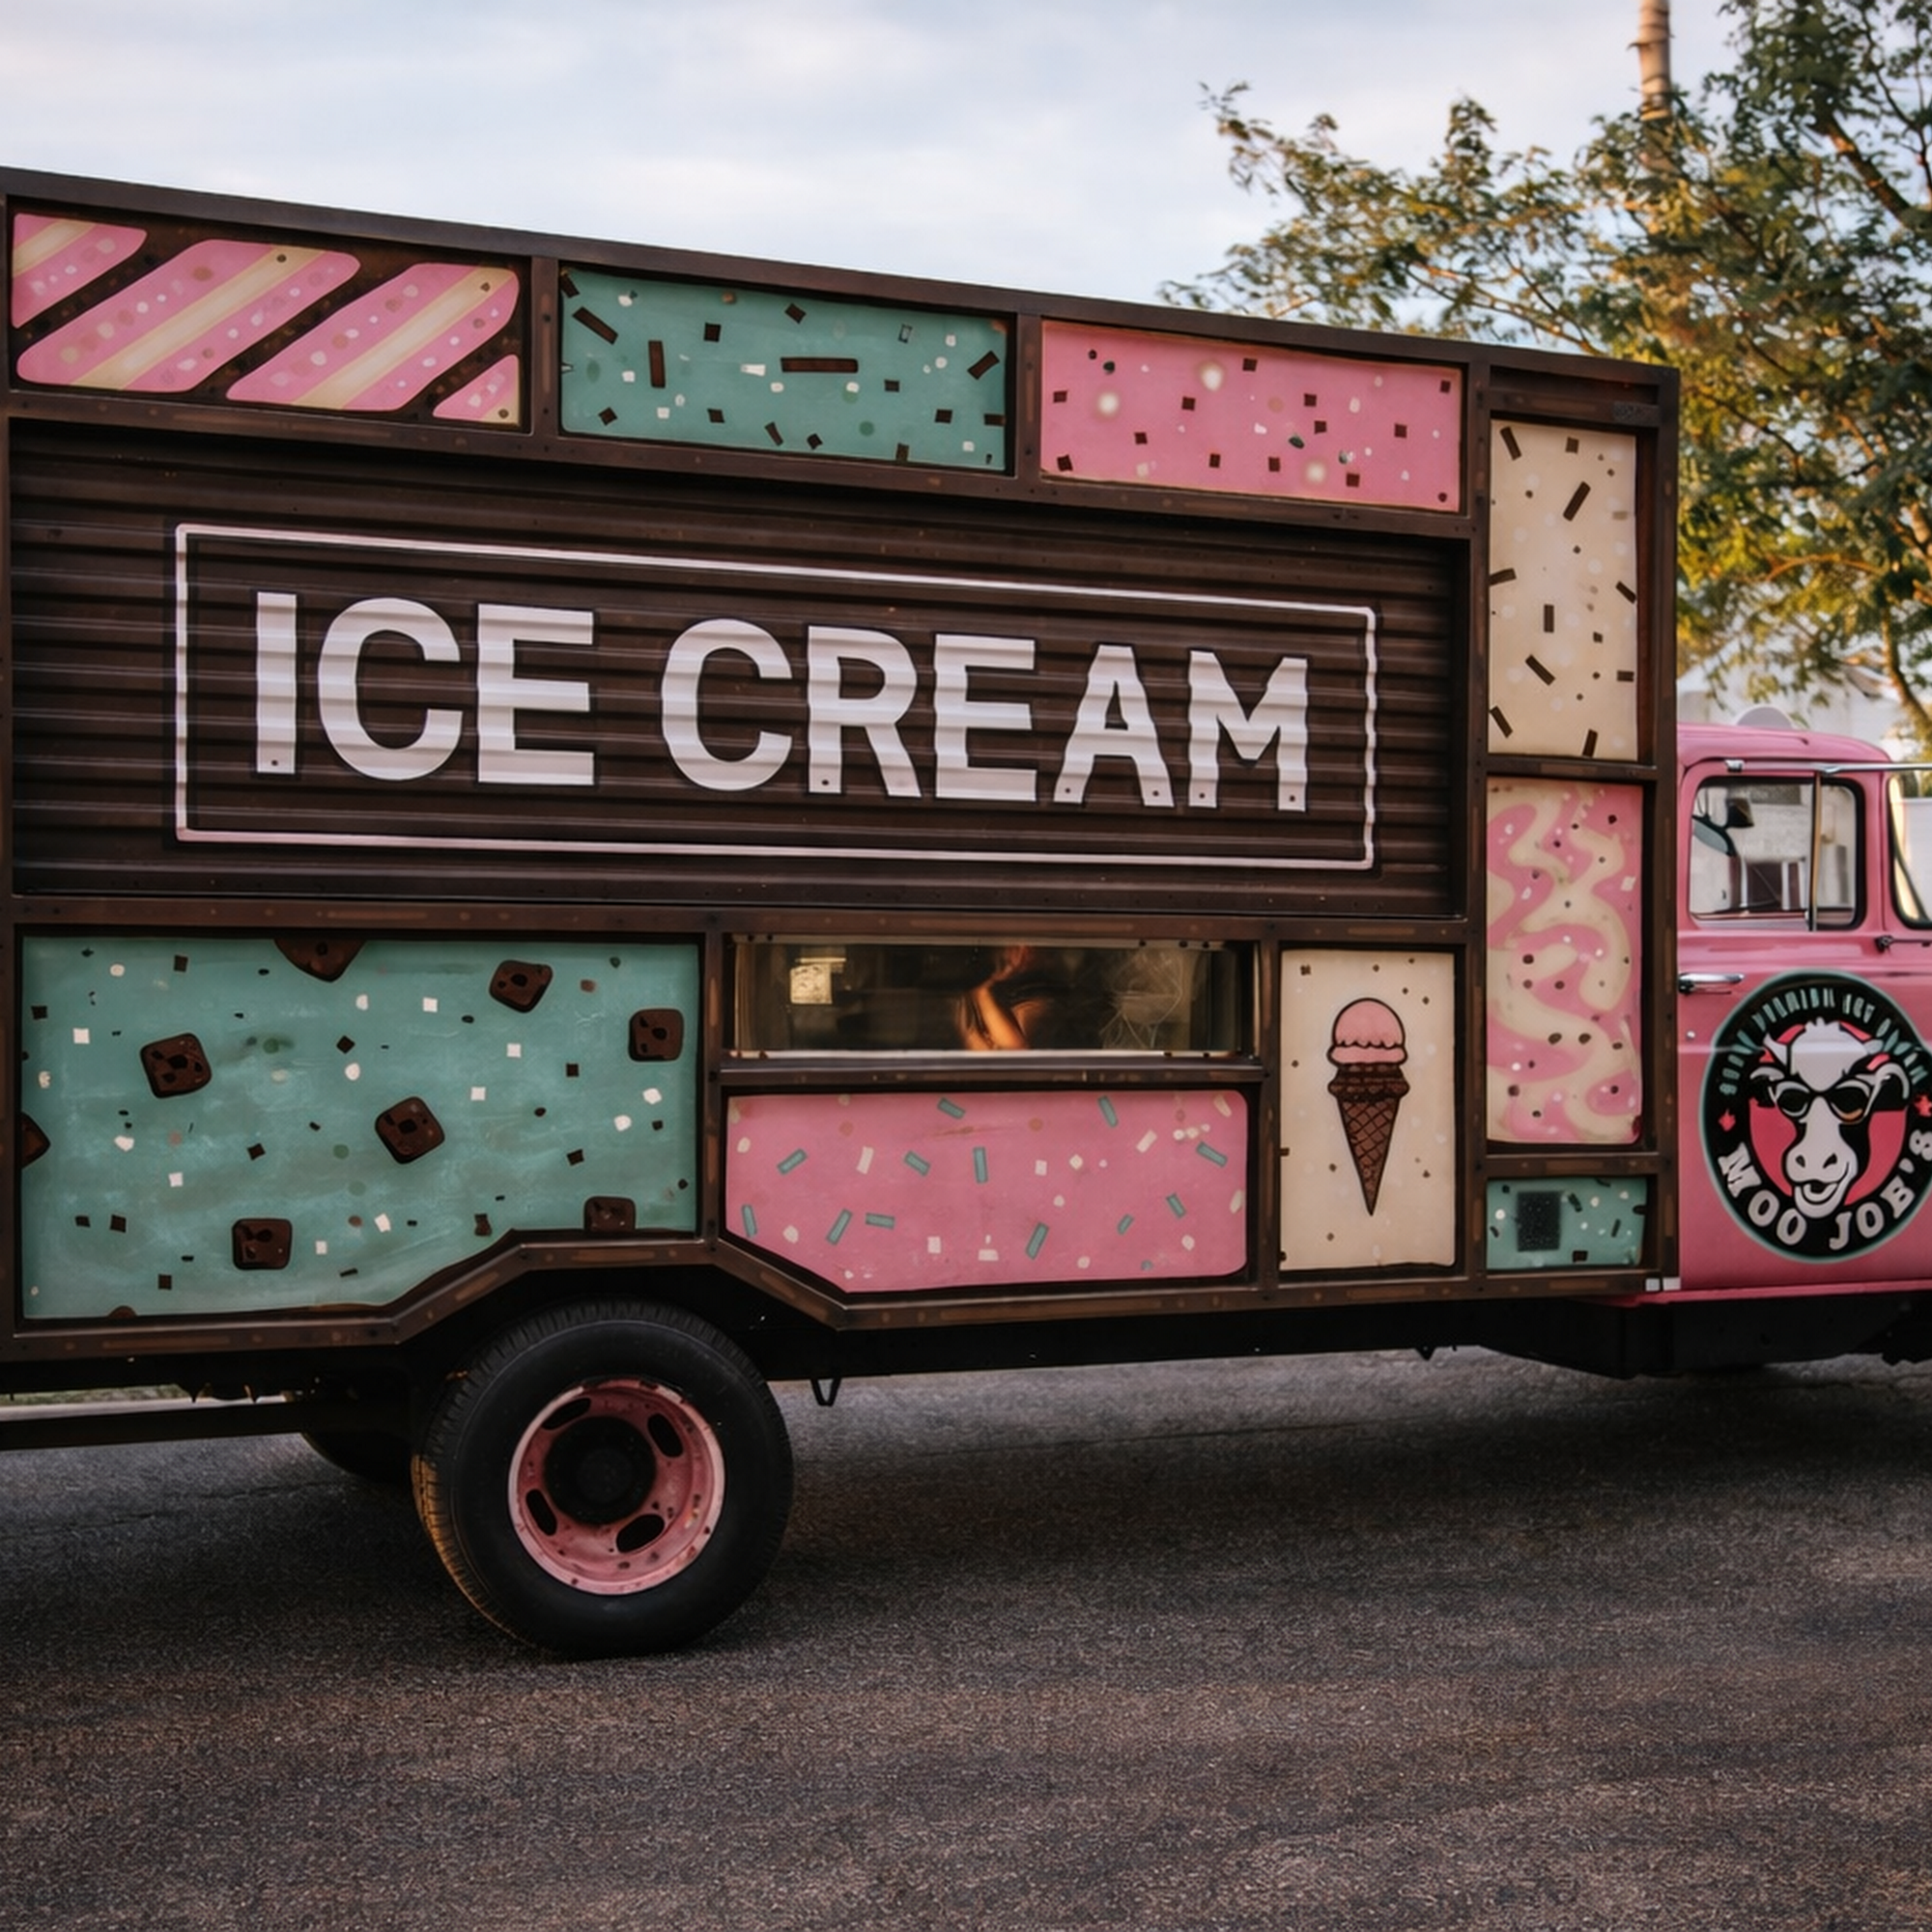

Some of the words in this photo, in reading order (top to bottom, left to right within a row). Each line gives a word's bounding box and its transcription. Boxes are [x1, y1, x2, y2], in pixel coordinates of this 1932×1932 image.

[257, 591, 594, 785] ICE
[661, 618, 1308, 812] CREAM
[1718, 1142, 1806, 1246] MOO
[1829, 1129, 1932, 1250] JOB'S
